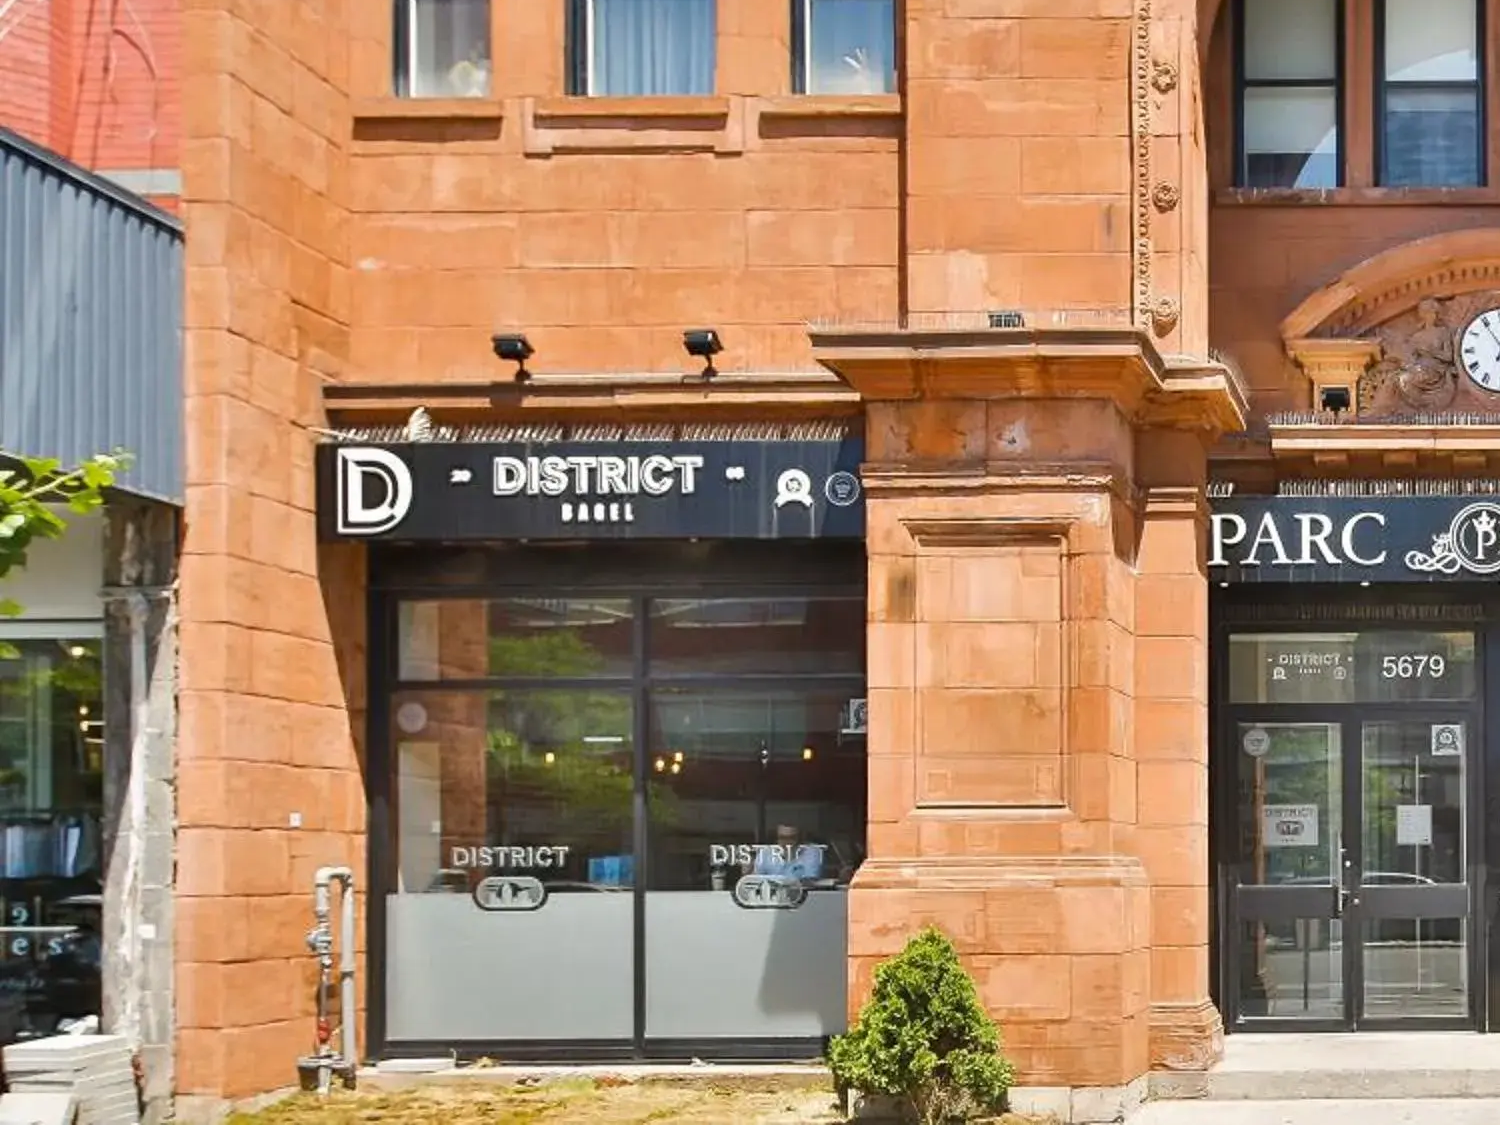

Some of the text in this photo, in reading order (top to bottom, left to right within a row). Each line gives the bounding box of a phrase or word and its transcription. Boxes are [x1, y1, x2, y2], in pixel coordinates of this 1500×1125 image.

[493, 456, 703, 497] DISTRICT
[337, 447, 412, 535] D
[1207, 512, 1387, 566] PARC
[1279, 653, 1341, 666] DISTRICT
[1382, 655, 1445, 678] 5679
[451, 846, 569, 868] DISTRICT
[709, 844, 828, 866] DISTRICT
